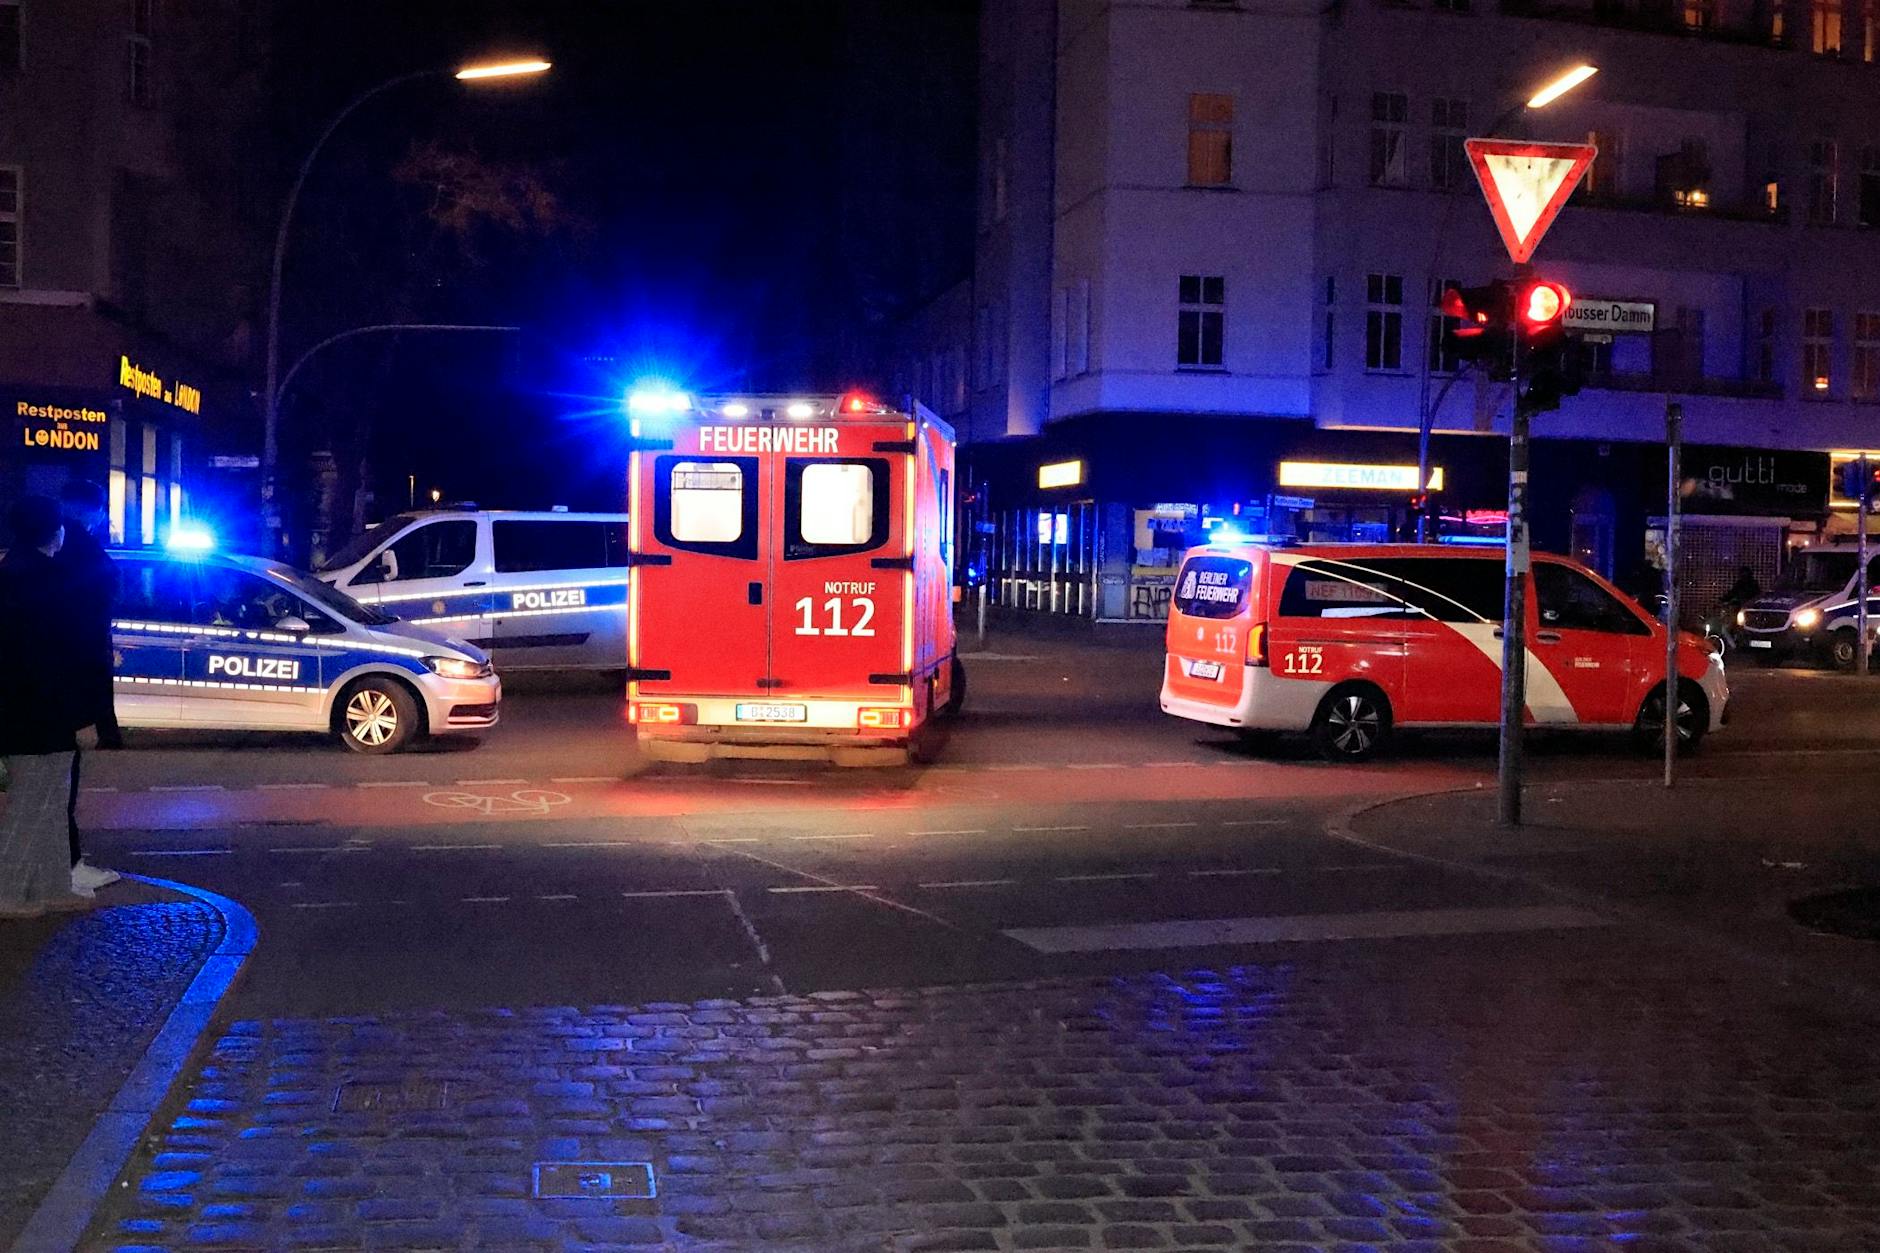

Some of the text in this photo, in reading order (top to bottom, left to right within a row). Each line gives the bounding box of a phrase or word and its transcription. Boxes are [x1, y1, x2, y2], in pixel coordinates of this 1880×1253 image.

[1564, 304, 1650, 323] busser Damm
[120, 355, 162, 399] Restposten
[17, 401, 106, 422] Restposten
[24, 427, 99, 450] LONDON
[699, 426, 839, 453] FEUERWEHR
[1322, 467, 1402, 484] ZEEMAN
[824, 582, 876, 595] NOTRUF
[1198, 571, 1228, 586] BERLINER
[512, 589, 586, 609] POLIZEI
[1195, 584, 1239, 603] FEUERWEHR
[1311, 584, 1338, 598] NEF
[794, 597, 876, 637] 112
[1215, 632, 1237, 653] 112
[208, 656, 299, 680] POLIZEI
[1283, 653, 1323, 674] 112
